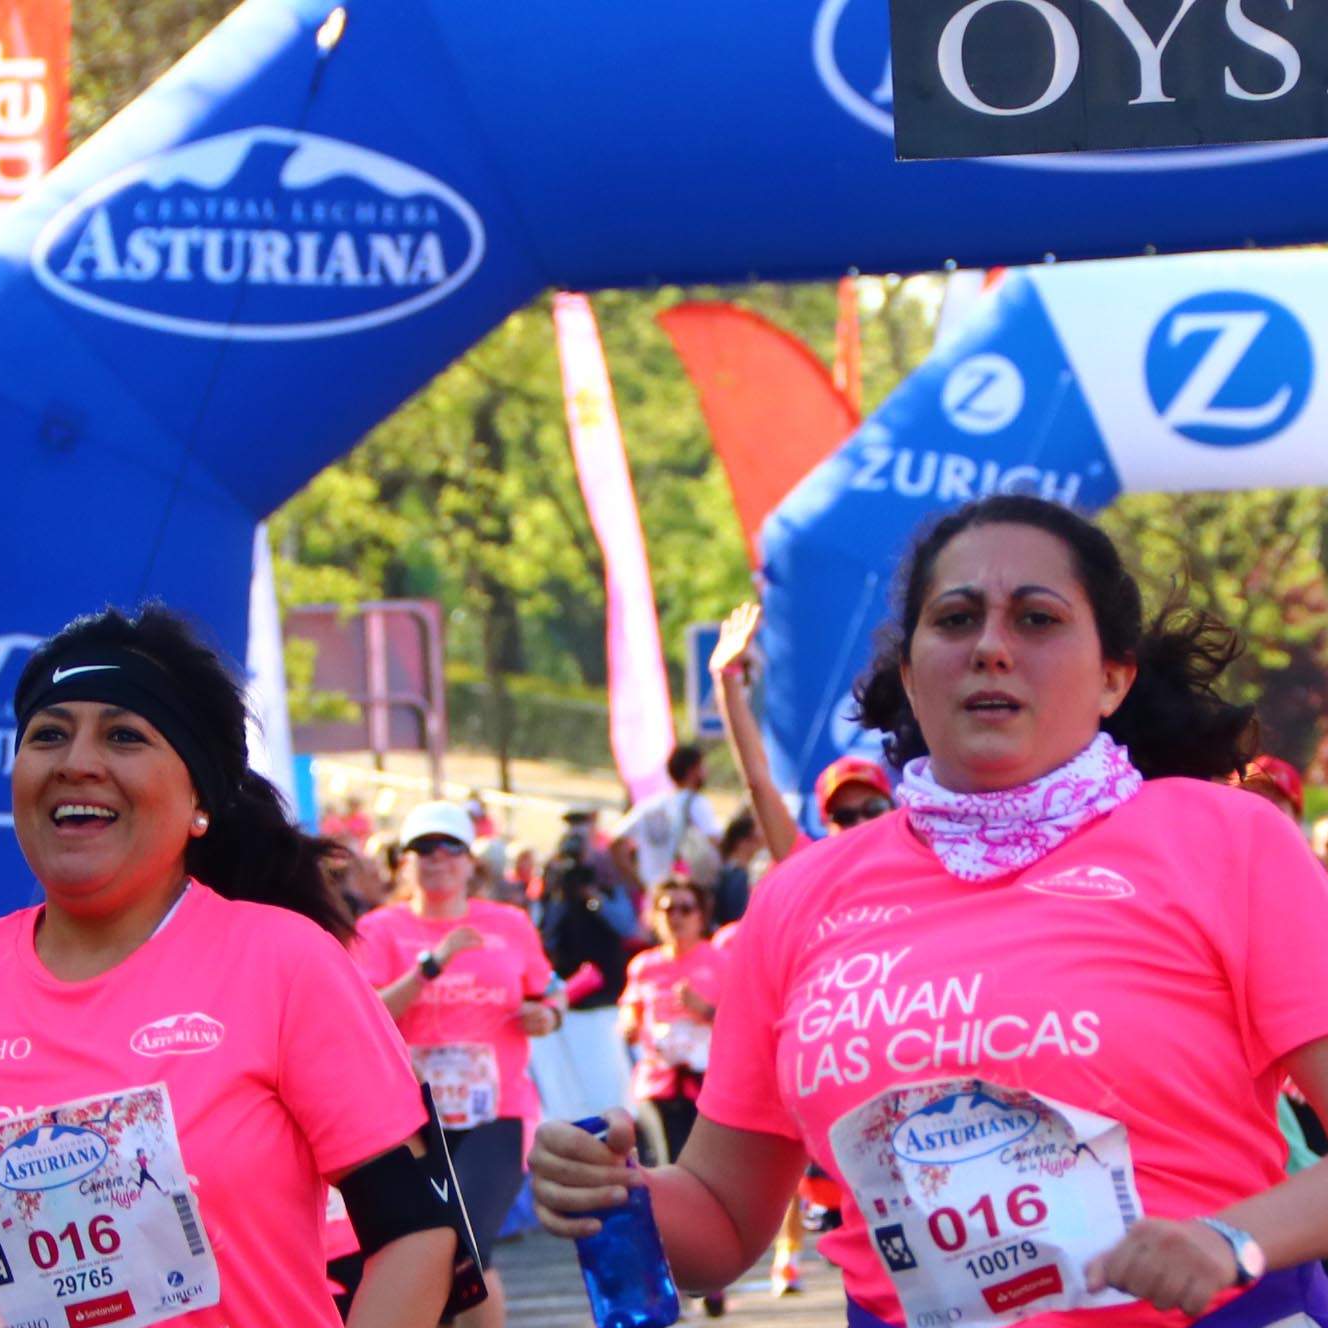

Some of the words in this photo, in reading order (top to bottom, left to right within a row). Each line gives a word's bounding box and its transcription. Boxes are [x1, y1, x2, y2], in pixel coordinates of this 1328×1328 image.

[62, 205, 447, 286] ASTURIANA
[807, 947, 912, 1002] HOY
[798, 974, 982, 1043] GANAN
[797, 1036, 870, 1097] LAS
[886, 1011, 1100, 1072] CHICAS
[906, 1114, 1029, 1154] ASTURIANA
[5, 1145, 100, 1182] ASTURIANA
[28, 1214, 121, 1270] 016
[928, 1184, 1049, 1252] 016
[53, 1266, 113, 1297] 29765
[966, 1240, 1039, 1279] 10079
[85, 1303, 122, 1318] Santander
